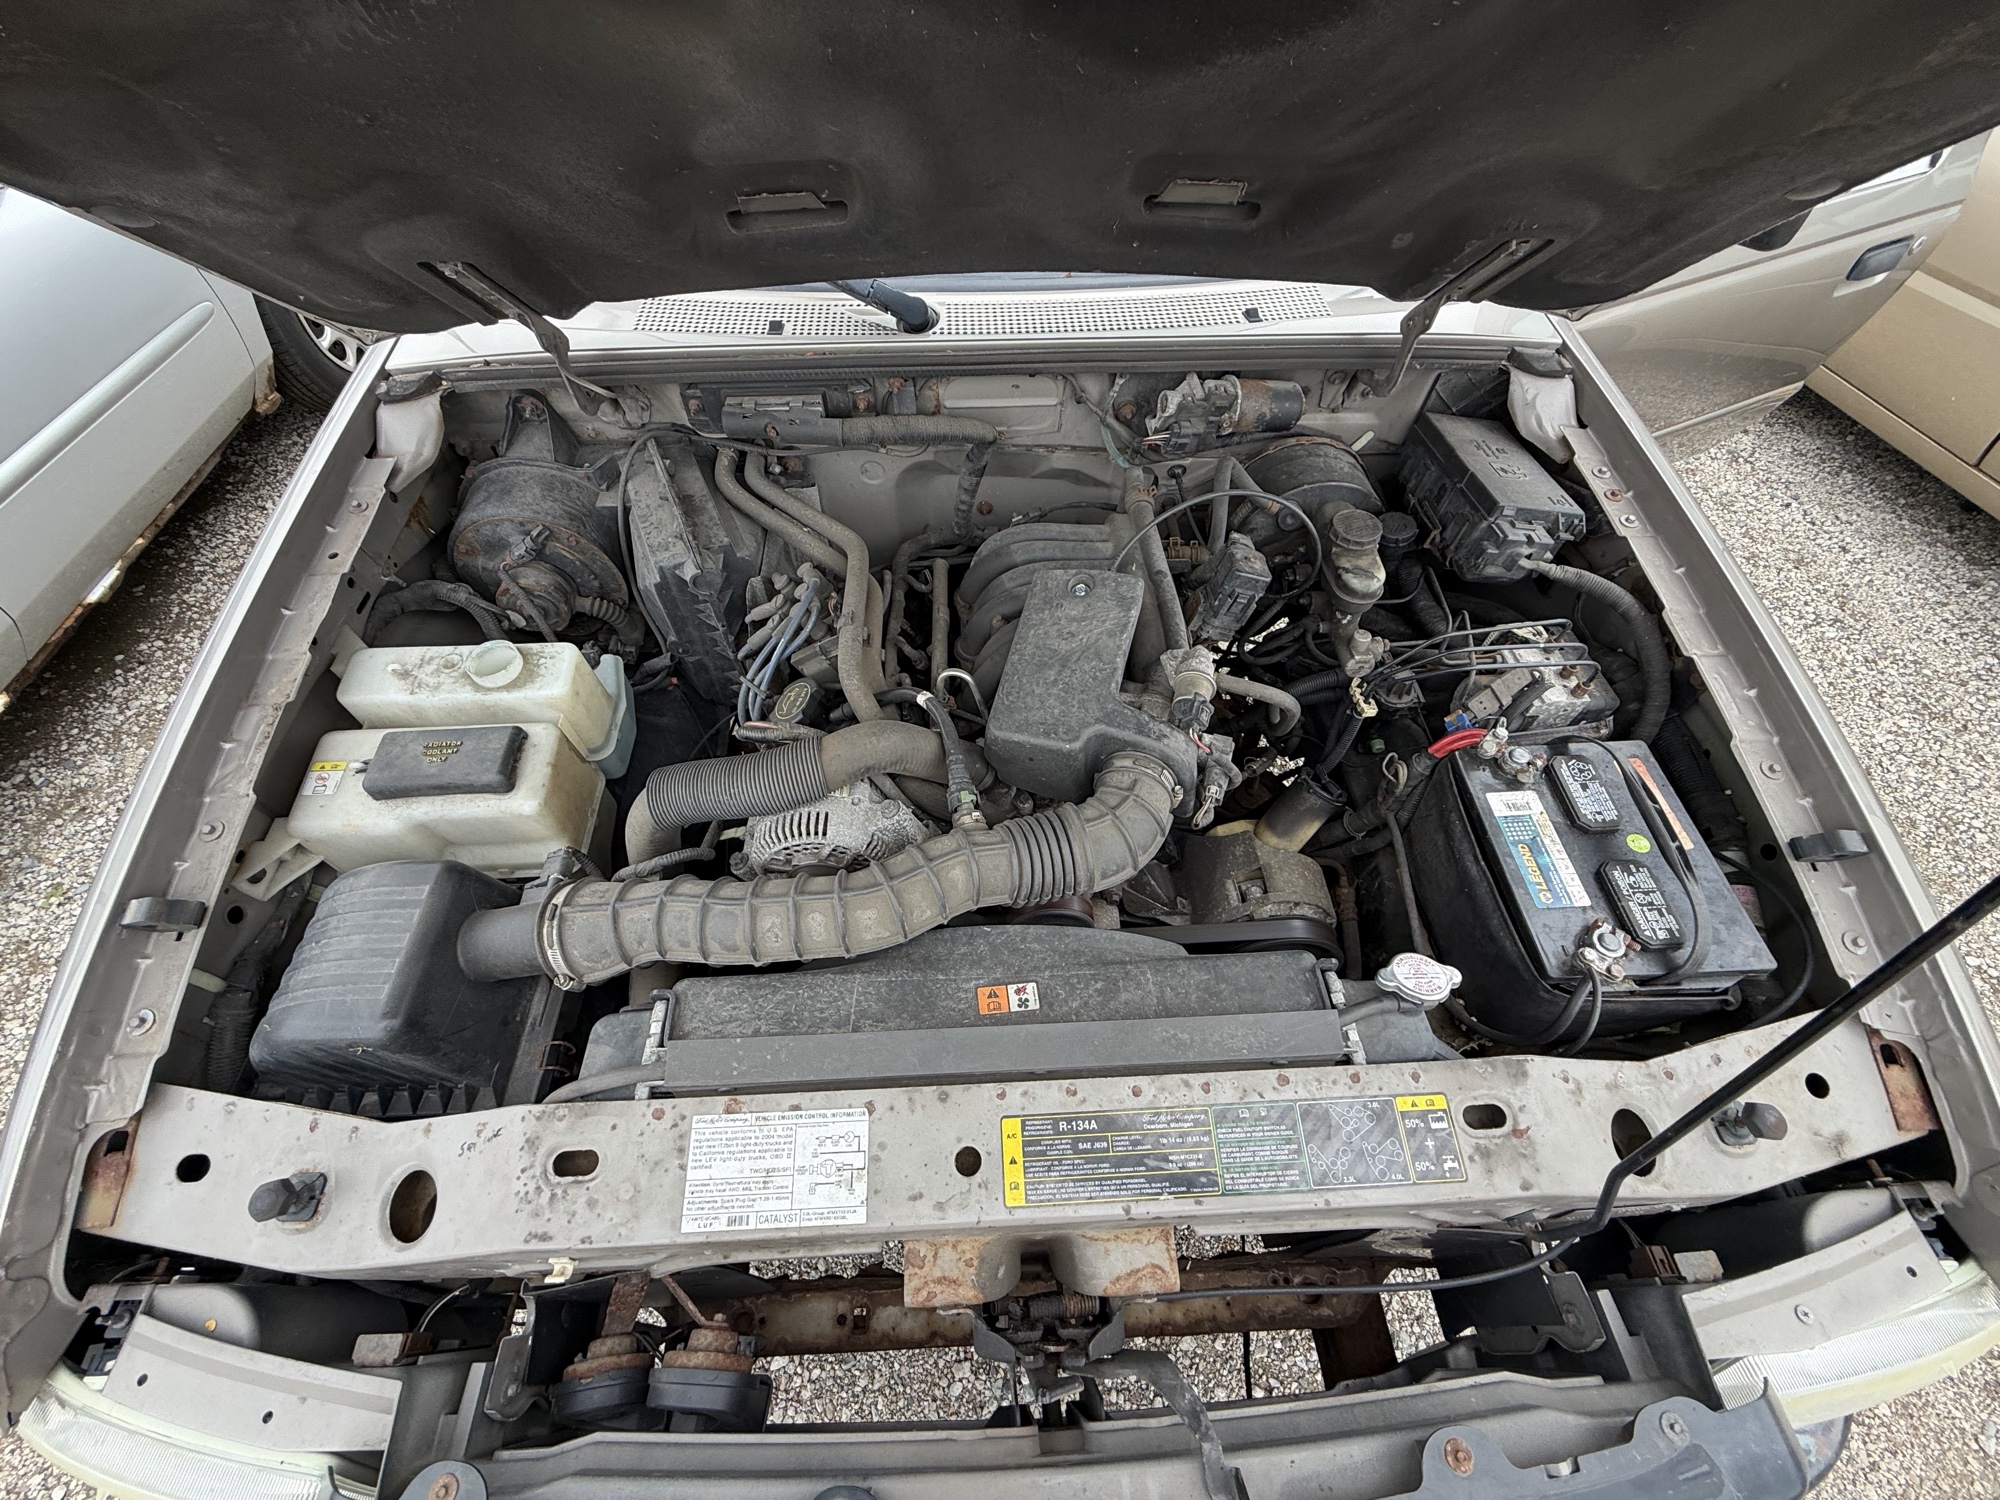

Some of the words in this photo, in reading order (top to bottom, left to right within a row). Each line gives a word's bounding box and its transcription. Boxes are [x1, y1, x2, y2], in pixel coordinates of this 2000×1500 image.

[1518, 843, 1548, 891] LEGEND
[1612, 870, 1630, 894] POISON
[1629, 901, 1647, 929] DANGER
[1059, 1120, 1097, 1131] R-134A
[1405, 1119, 1424, 1128] 50%
[1415, 1161, 1435, 1171] 50%
[759, 1213, 798, 1224] CATALYST
